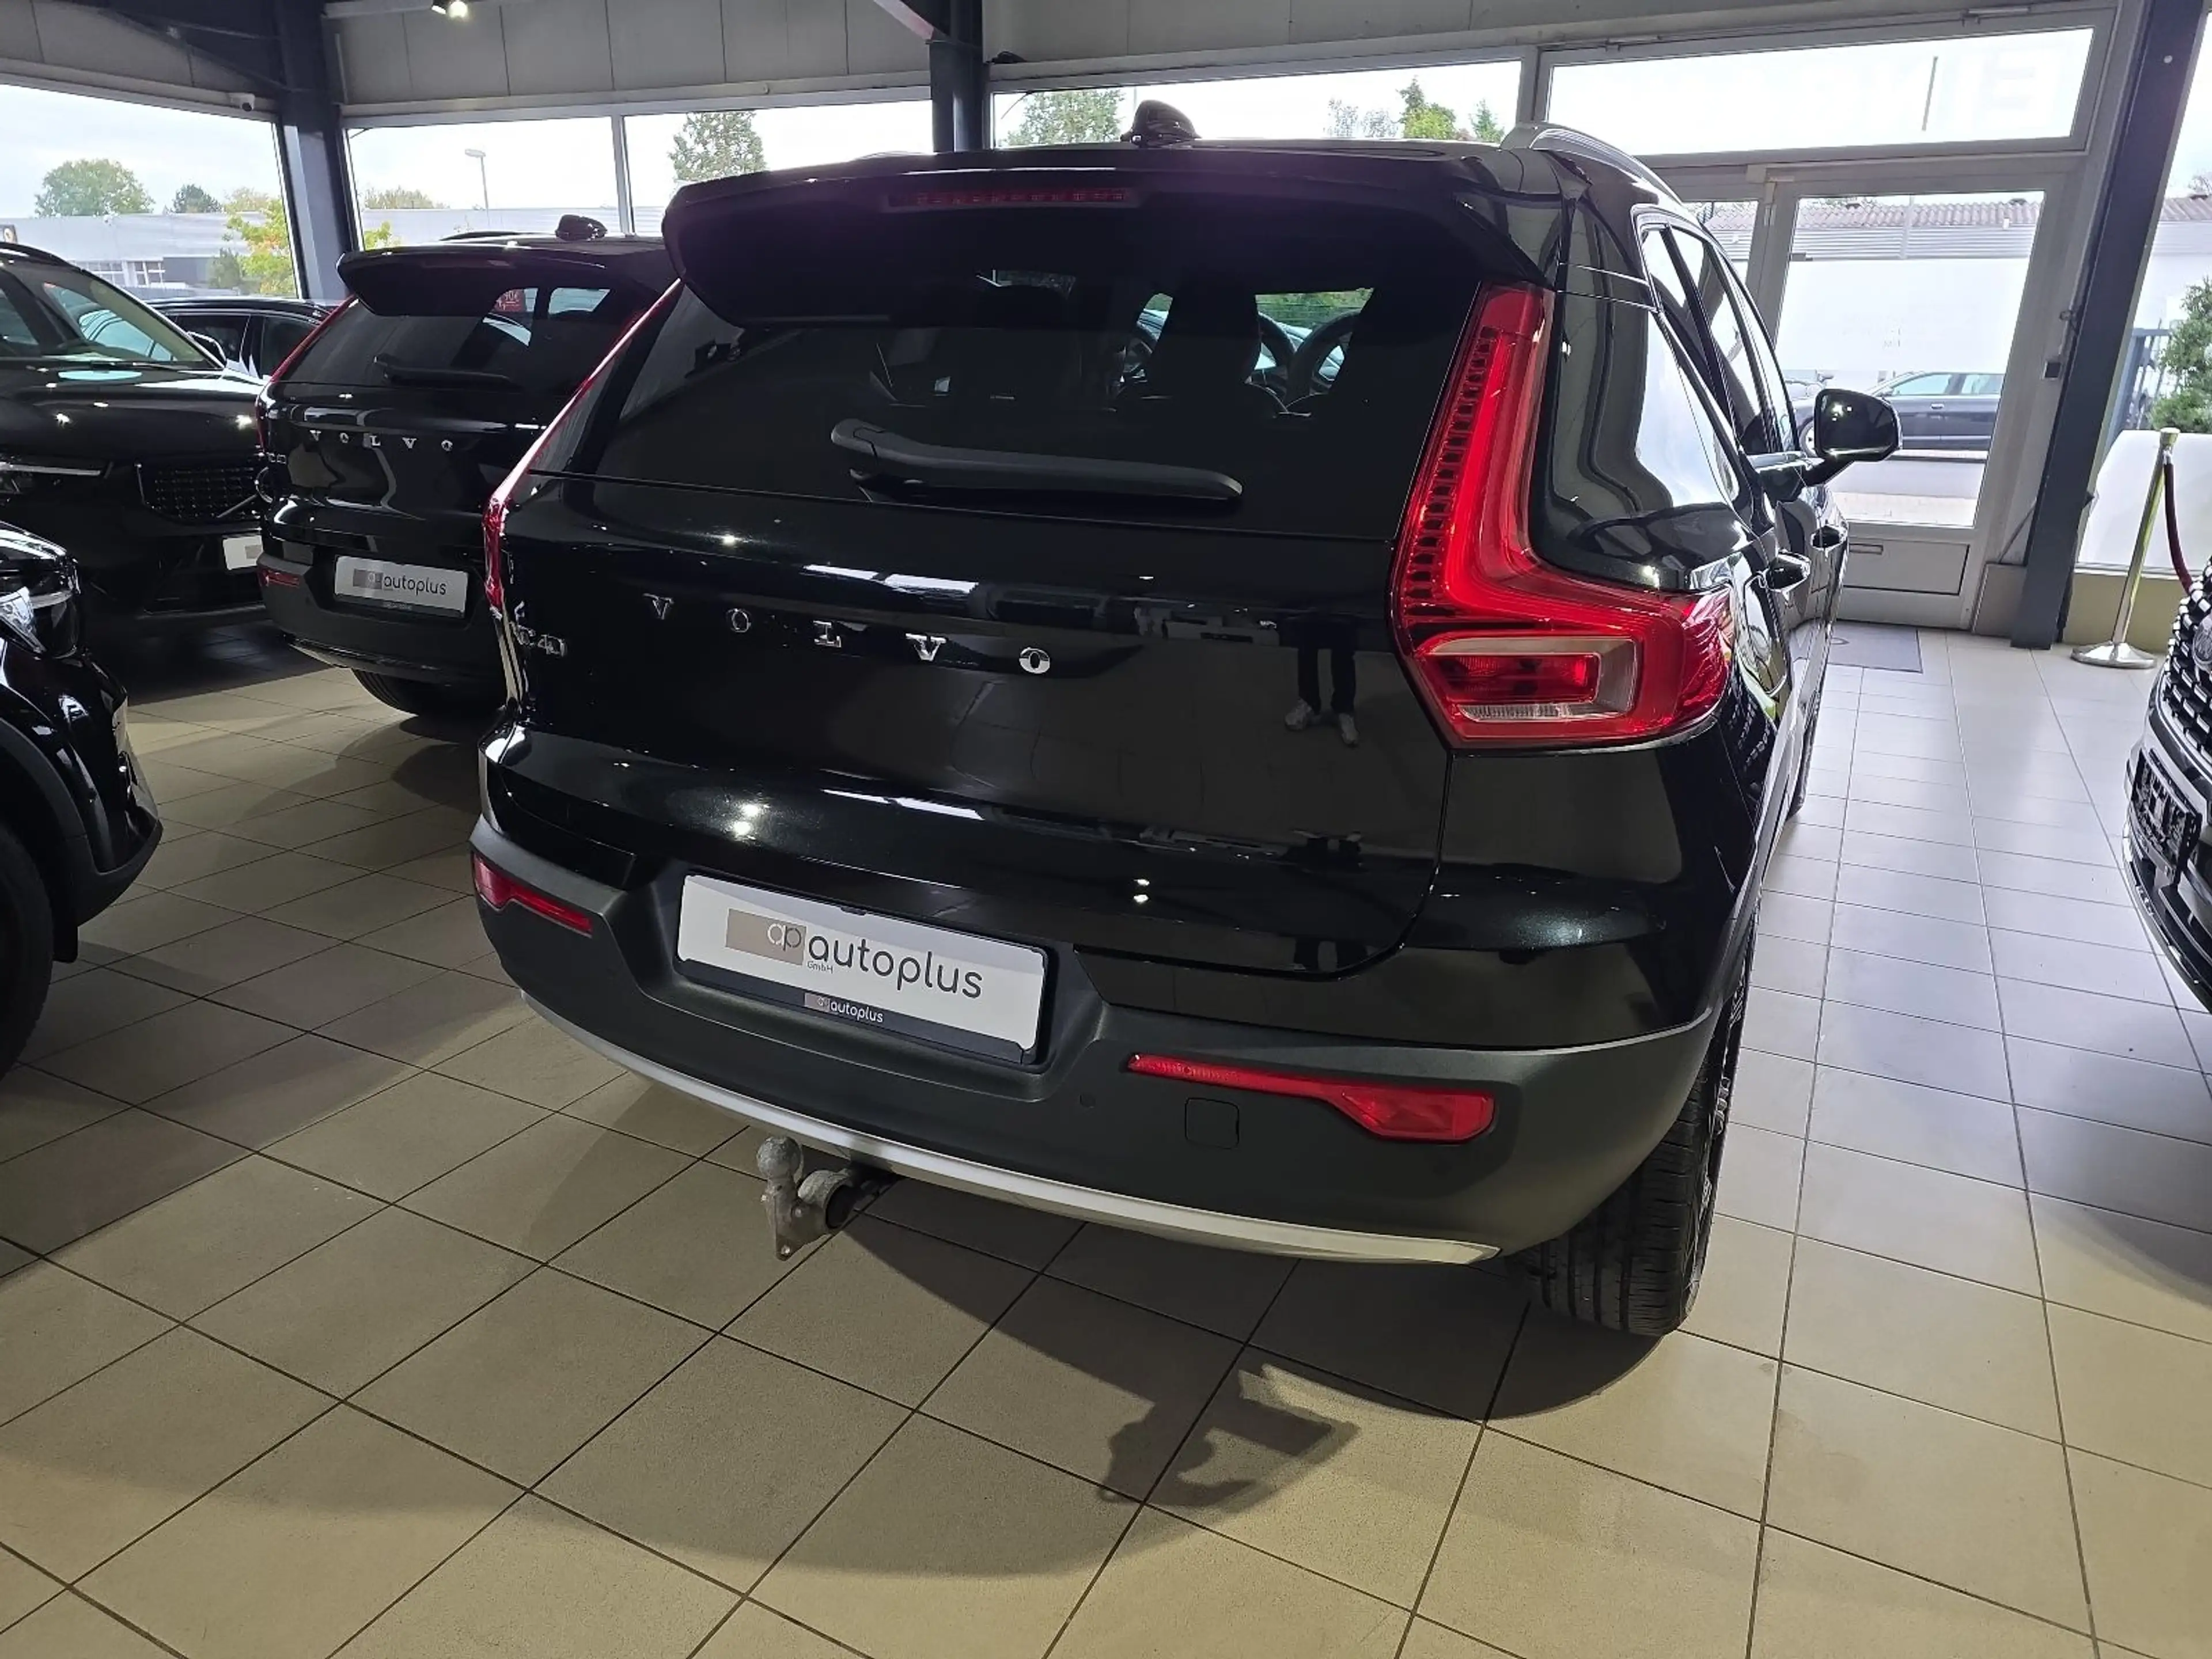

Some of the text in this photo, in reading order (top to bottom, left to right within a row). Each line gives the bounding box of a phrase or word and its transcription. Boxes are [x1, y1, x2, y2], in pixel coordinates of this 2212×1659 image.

[309, 429, 453, 452] VOLVO
[384, 575, 448, 596] autoplus
[643, 593, 1051, 675] VOLVO
[807, 960, 834, 974] GmbH
[808, 935, 983, 999] autoplus
[831, 1000, 884, 1023] autoplus
